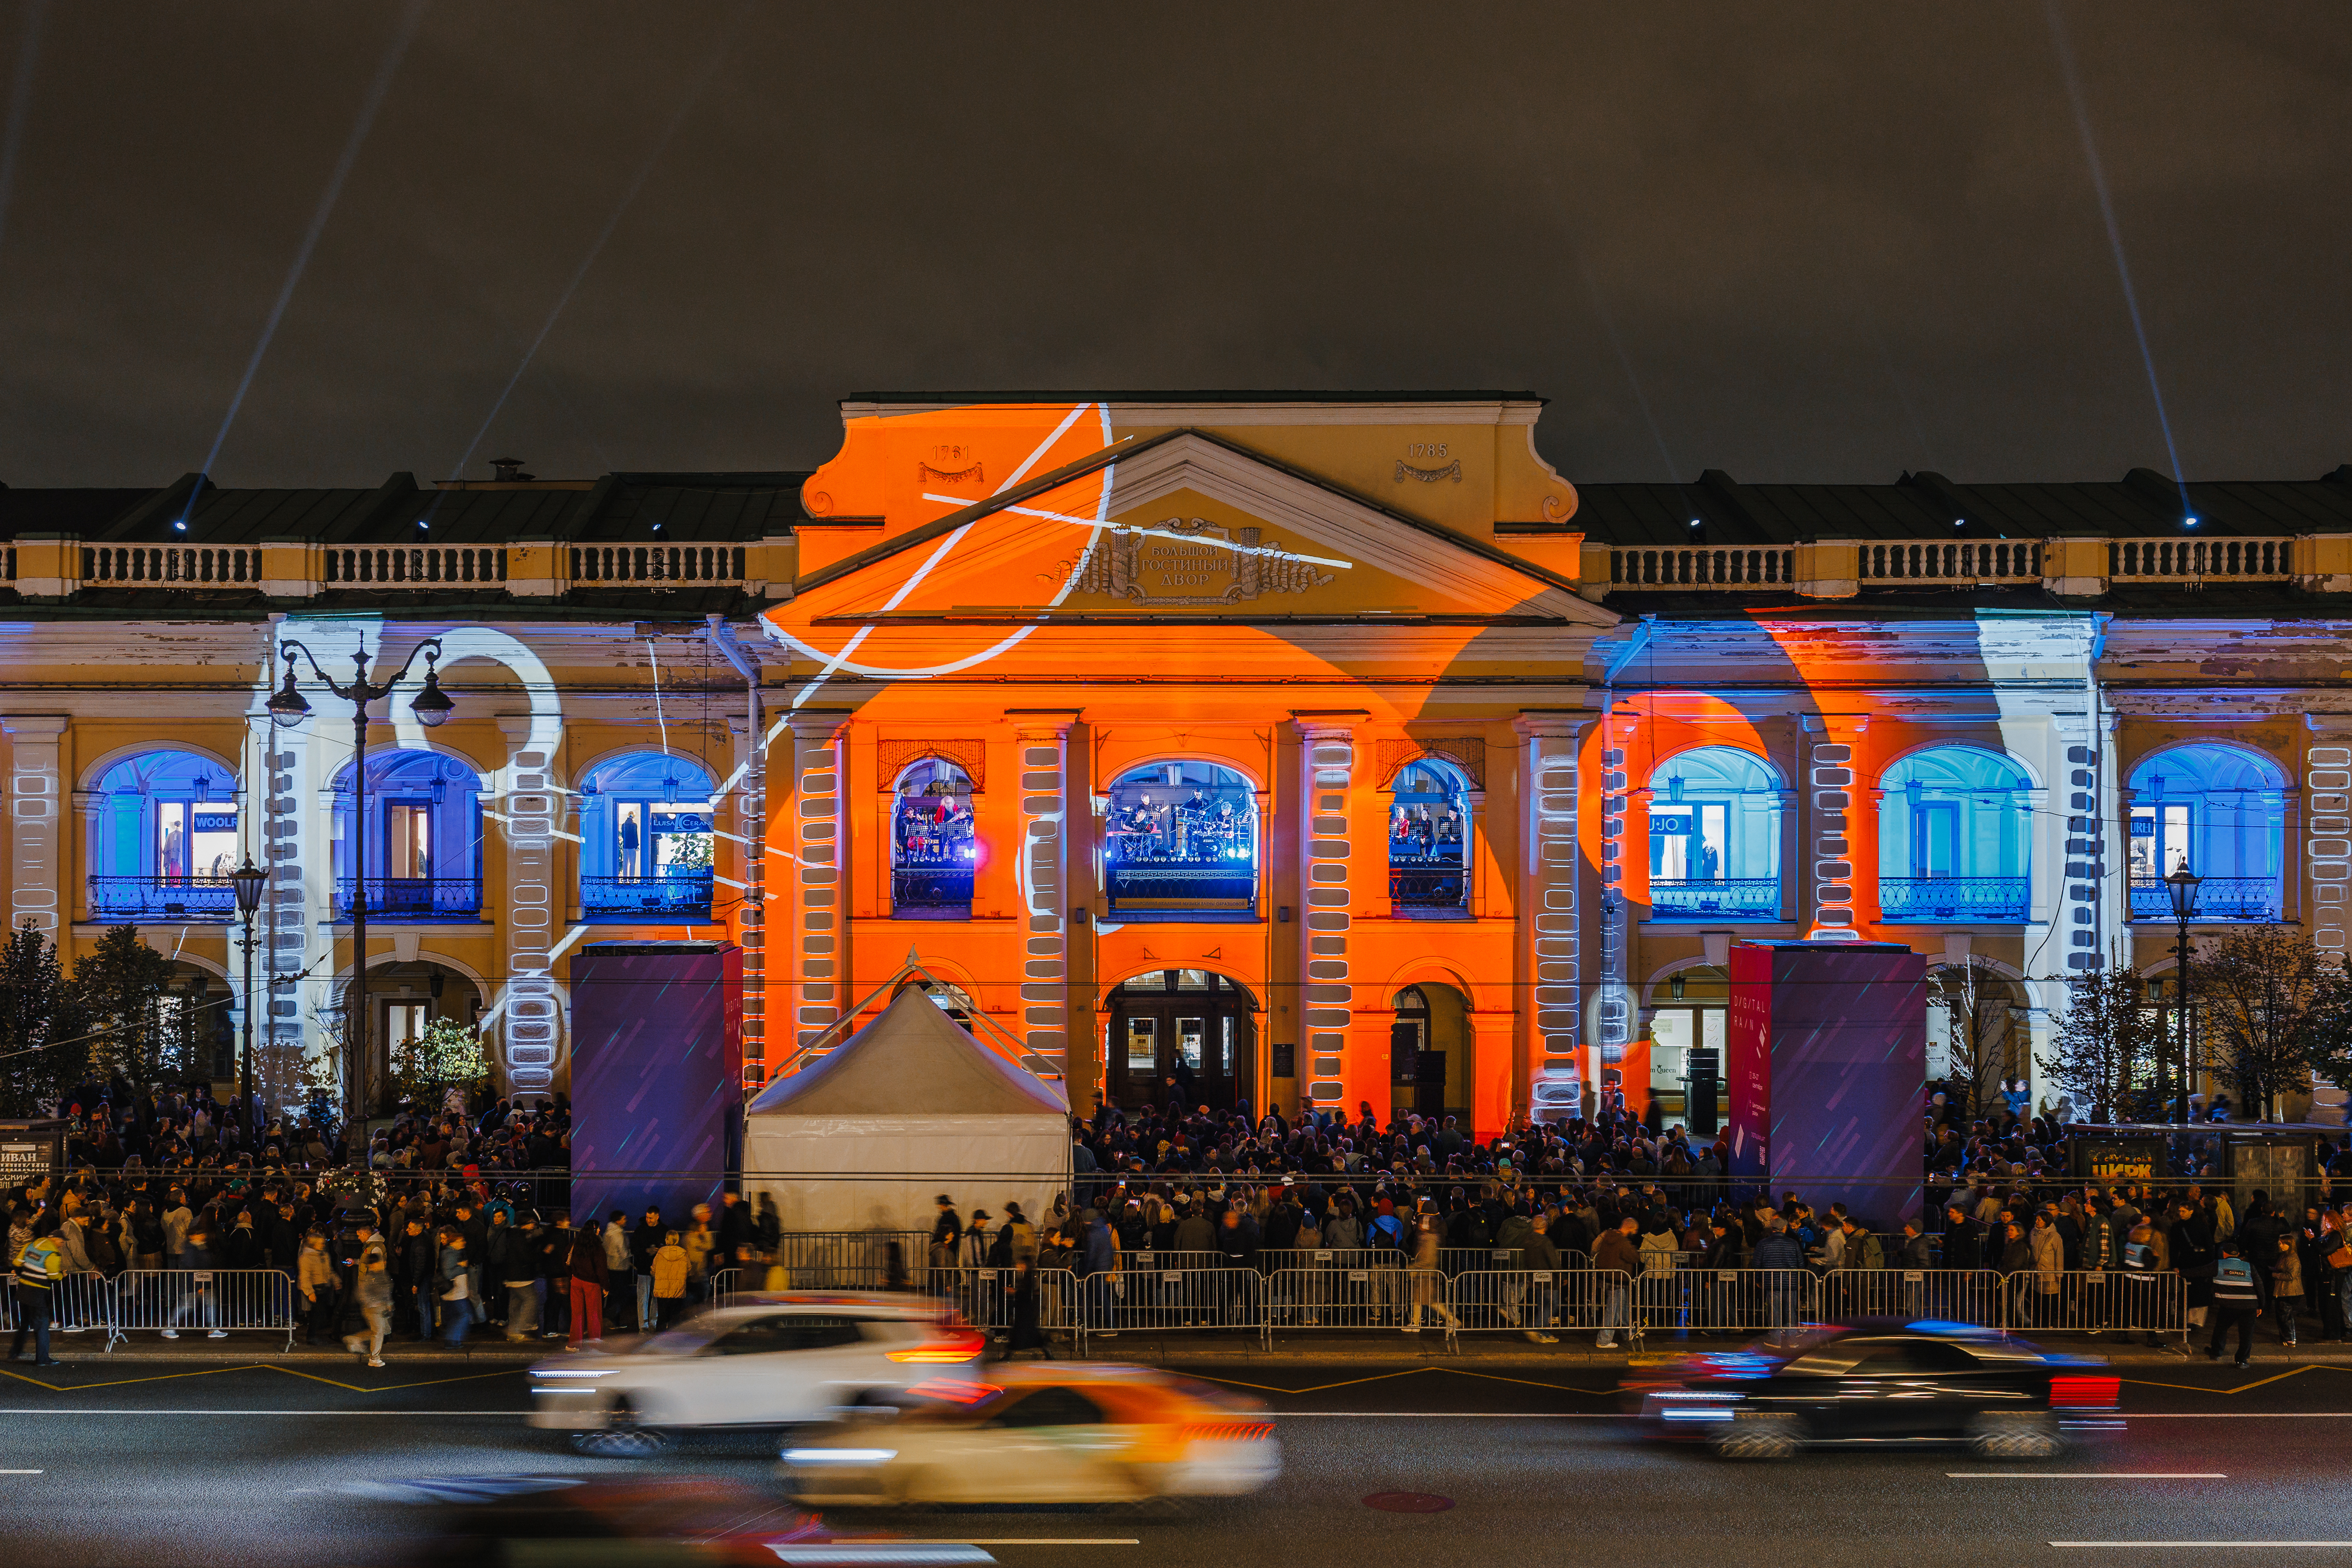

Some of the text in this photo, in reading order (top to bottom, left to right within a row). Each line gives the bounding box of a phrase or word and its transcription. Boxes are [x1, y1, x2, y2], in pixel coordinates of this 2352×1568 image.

[933, 445, 968, 460] 1761
[1409, 443, 1448, 457] 1785
[1151, 544, 1218, 556] БОЛЬШОЙ
[1142, 558, 1229, 571] ГОСТИНЫЙ
[1161, 574, 1210, 586] ДВОР
[1, 1153, 37, 1162] ИВАН
[2092, 1163, 2152, 1178] ЦИРК
